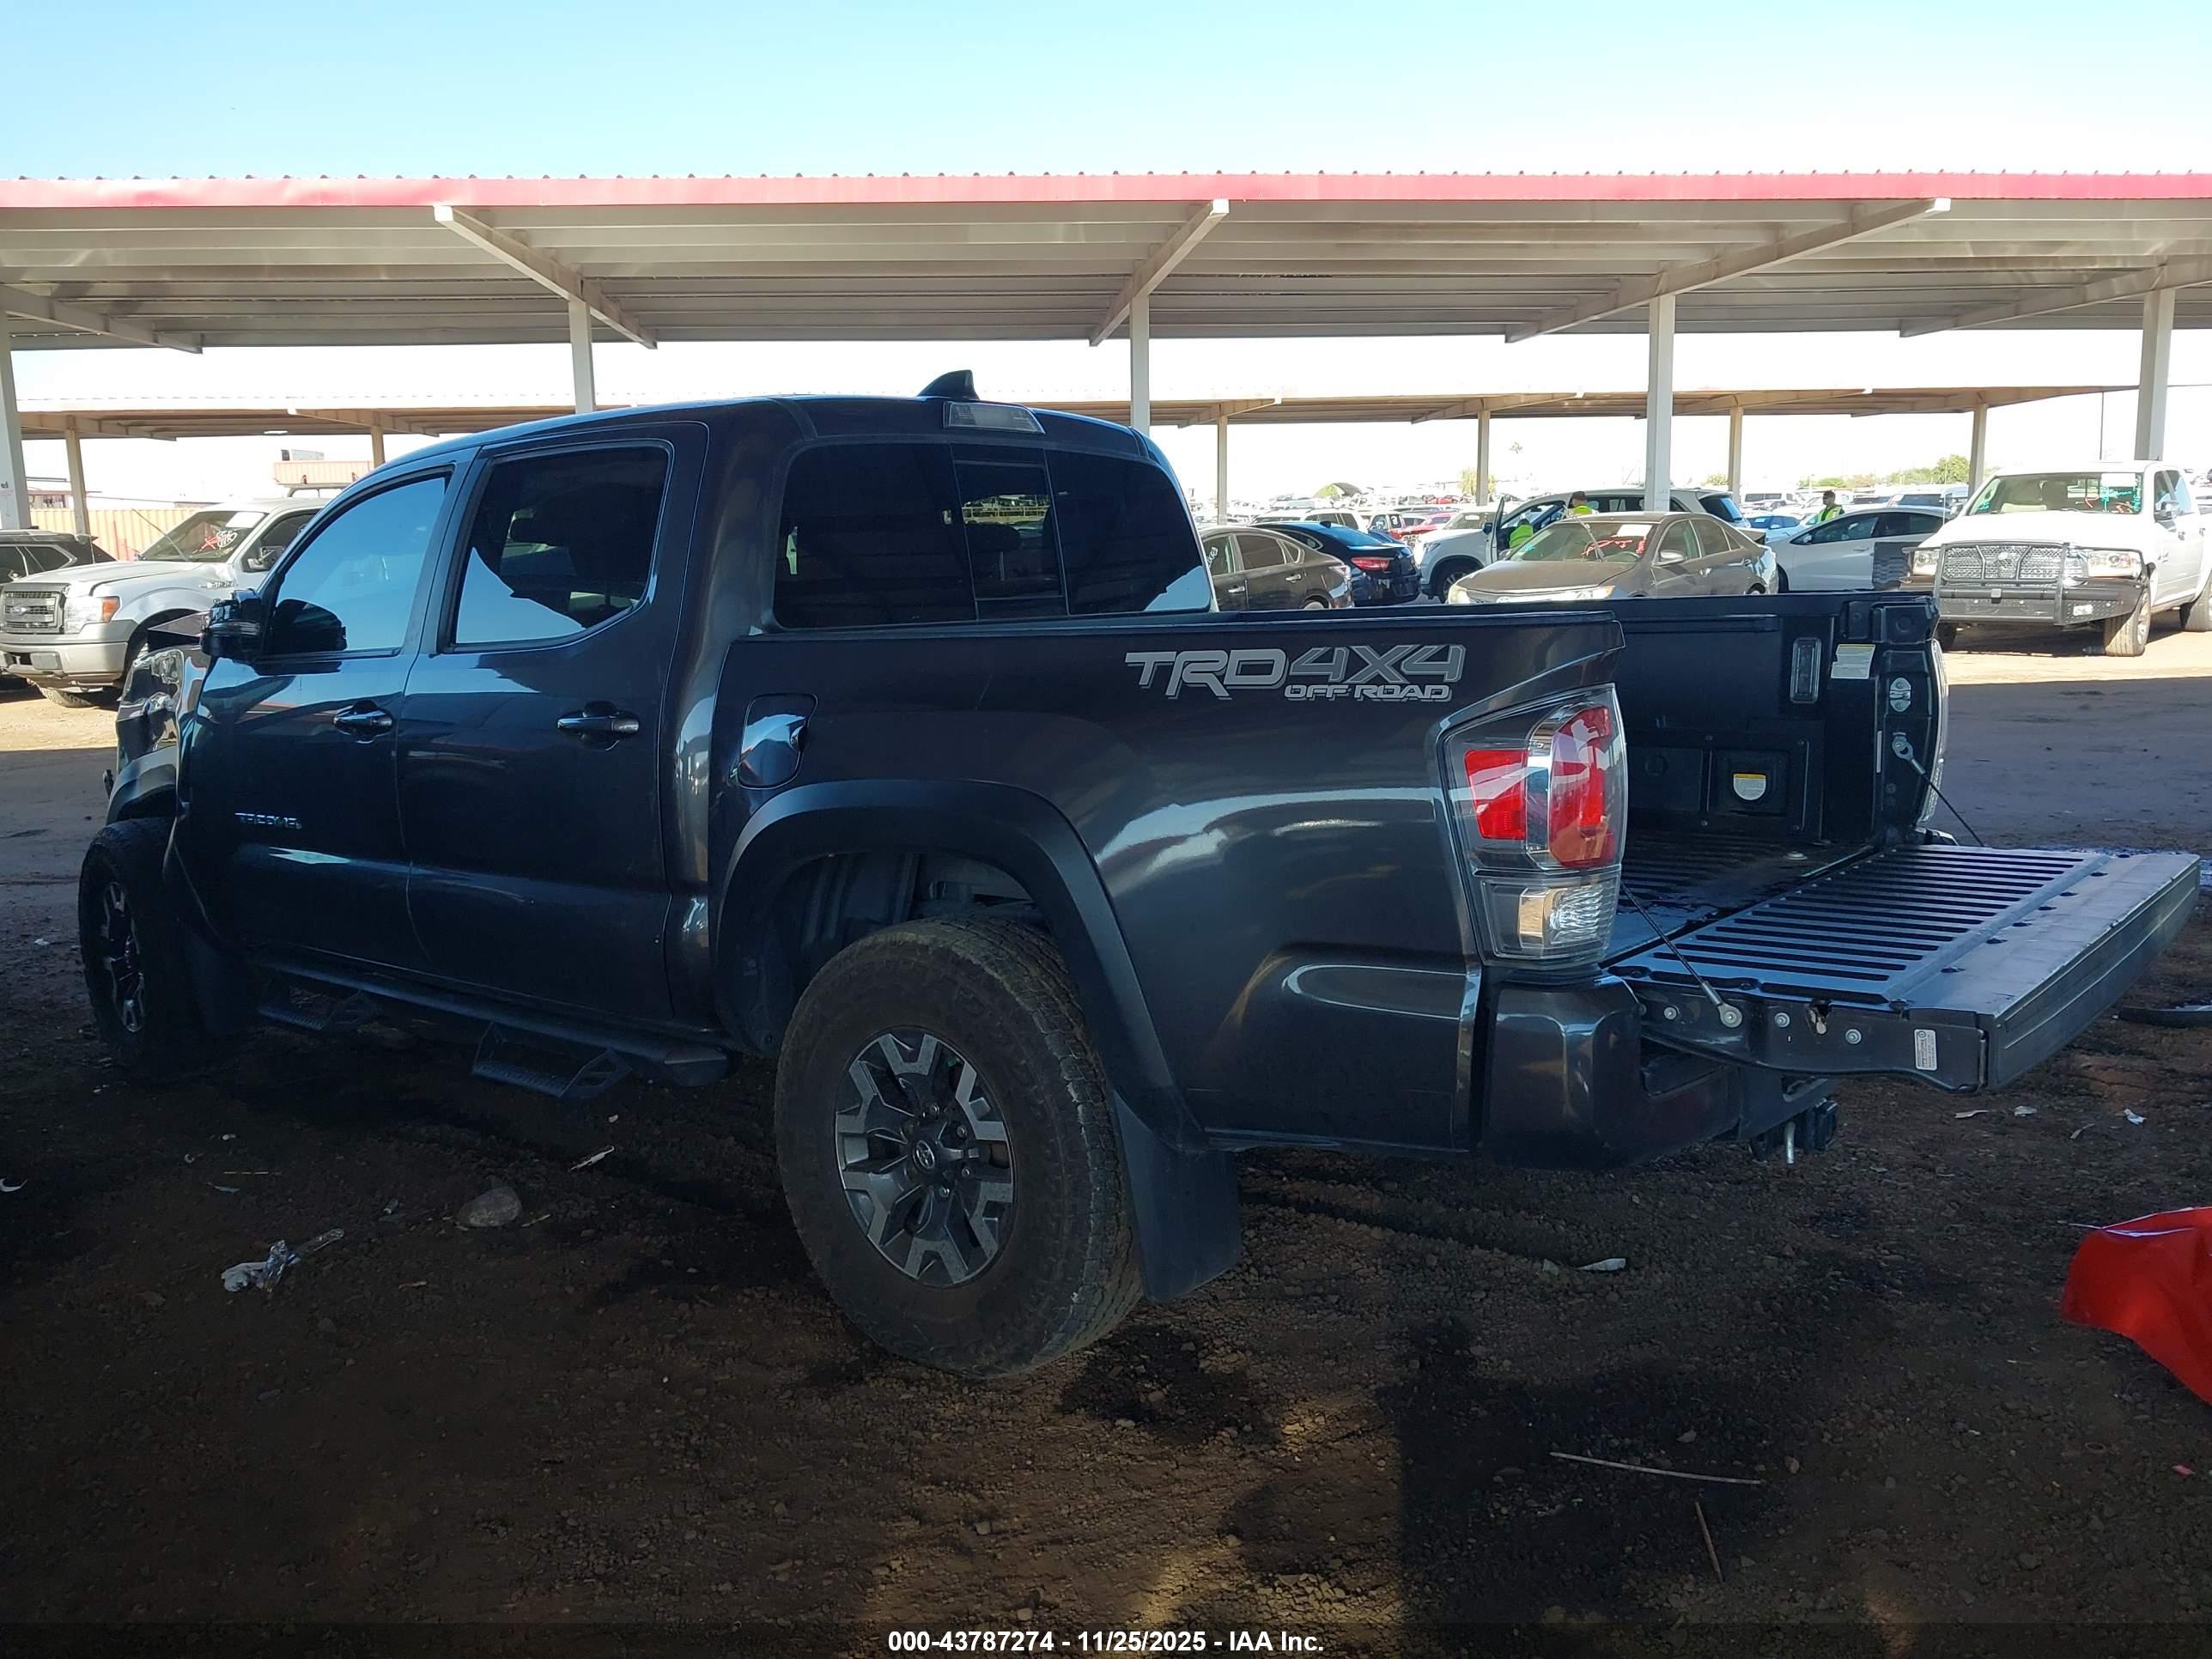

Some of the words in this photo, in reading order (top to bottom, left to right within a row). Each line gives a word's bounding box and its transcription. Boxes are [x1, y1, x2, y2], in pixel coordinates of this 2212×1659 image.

[1125, 647, 1289, 700] TRD
[1289, 645, 1467, 684] 4X4
[1284, 684, 1352, 702] OFF
[1353, 684, 1454, 702] ROAD
